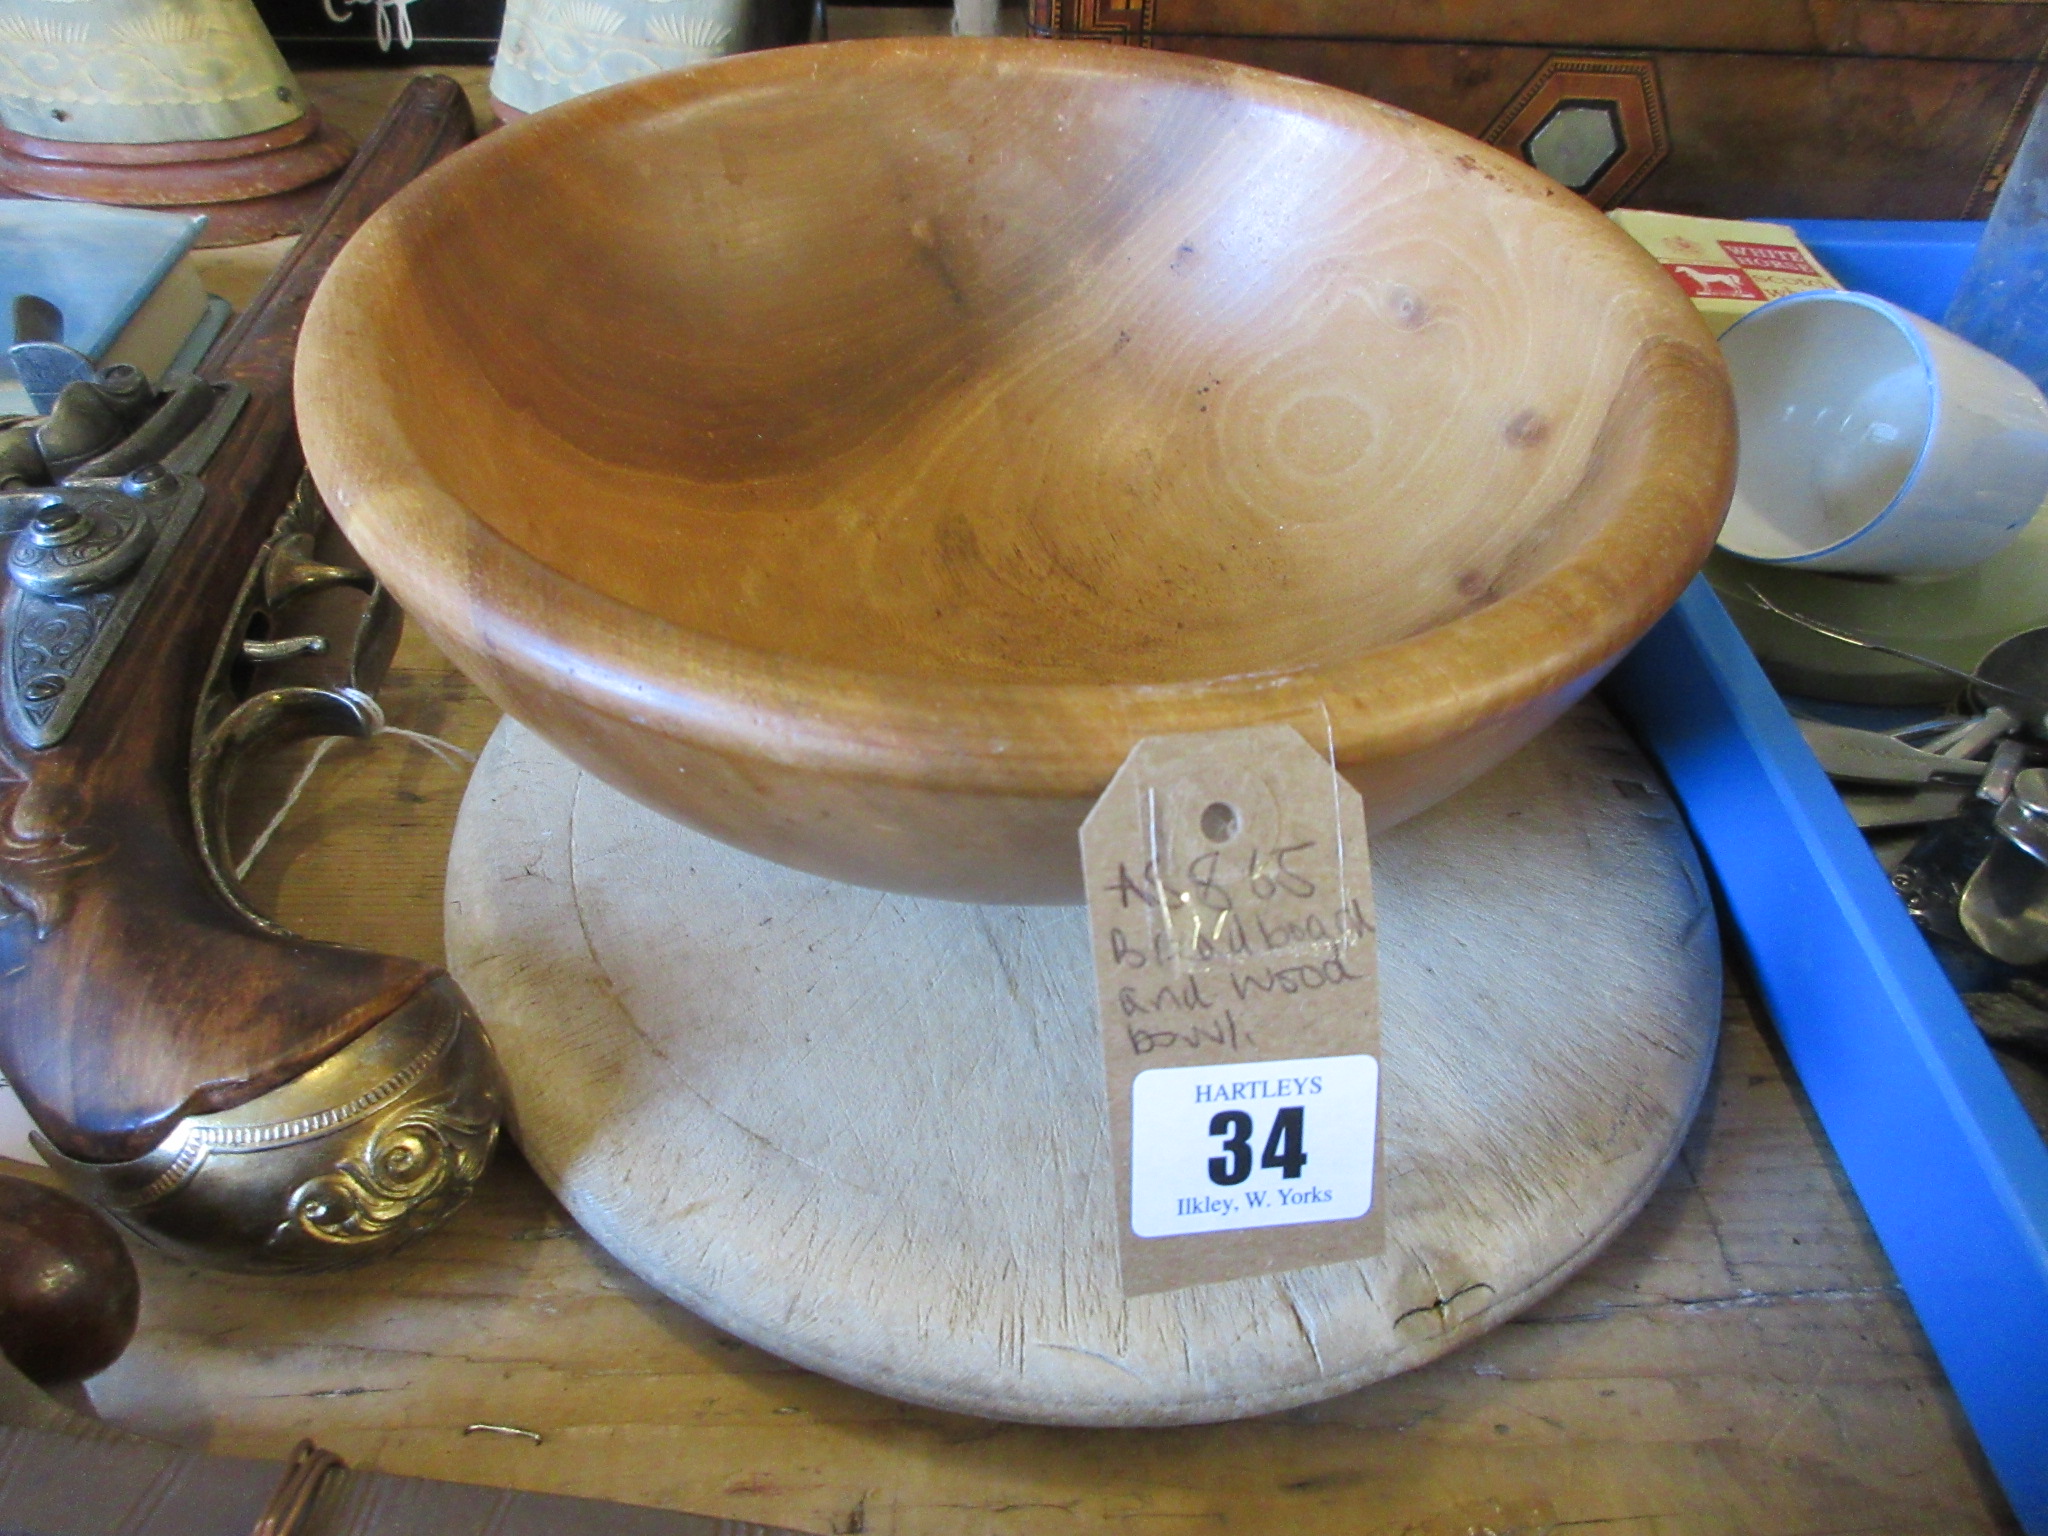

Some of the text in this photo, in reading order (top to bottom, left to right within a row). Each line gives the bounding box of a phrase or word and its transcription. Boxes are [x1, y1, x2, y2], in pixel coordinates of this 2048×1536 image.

[1722, 244, 1805, 263] WHITE
[1735, 256, 1818, 274] HORSE
[1118, 974, 1214, 1017] and
[1194, 1076, 1323, 1103] HARTLEYS
[1208, 1105, 1308, 1187] 34
[1176, 1185, 1334, 1217] Ilkley, W. Yorks
